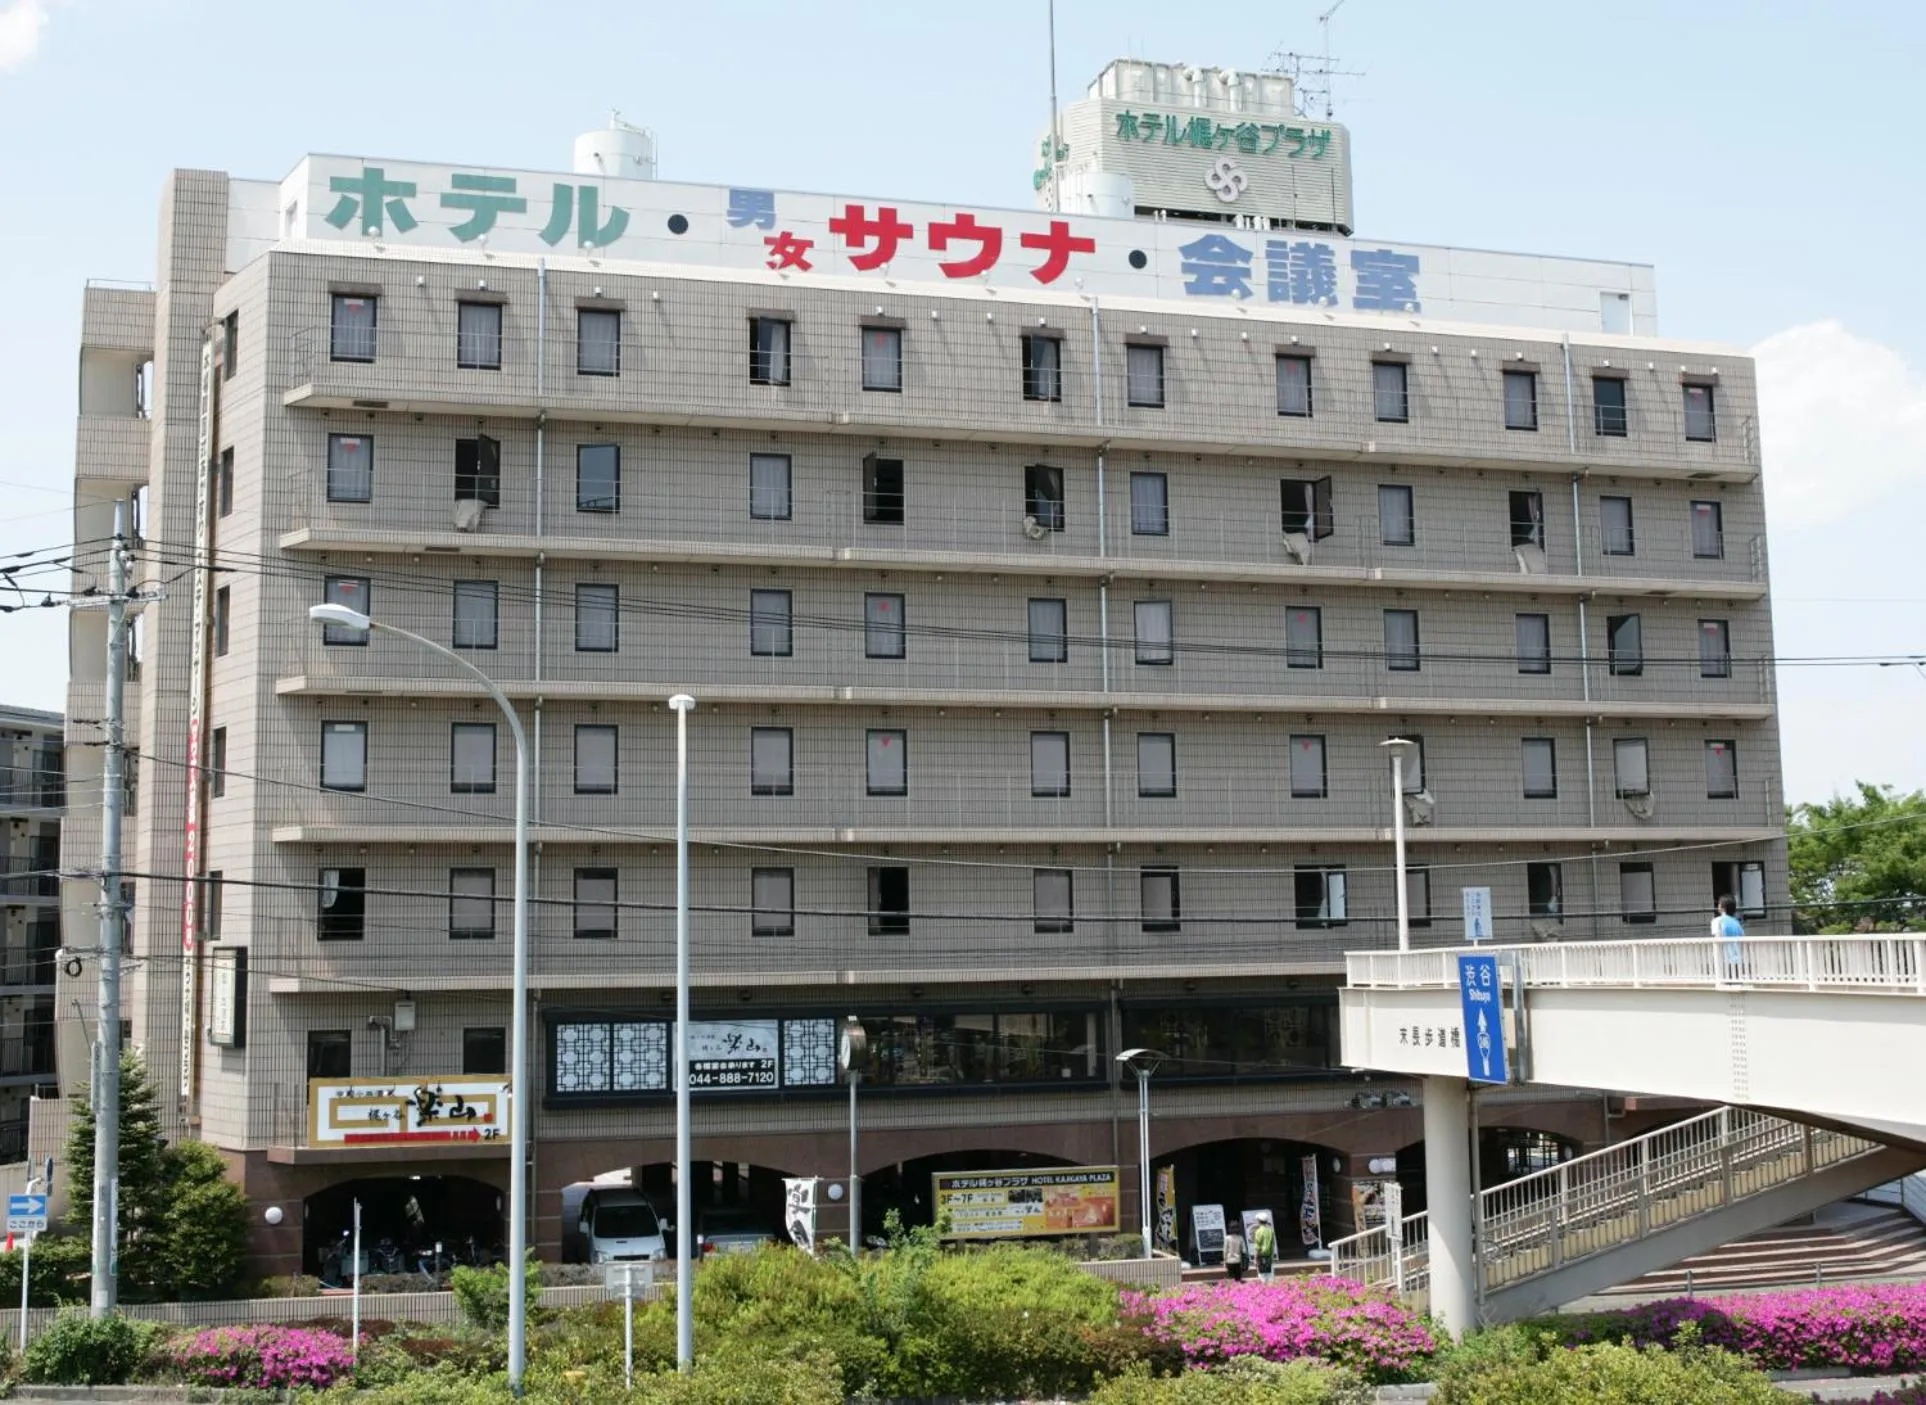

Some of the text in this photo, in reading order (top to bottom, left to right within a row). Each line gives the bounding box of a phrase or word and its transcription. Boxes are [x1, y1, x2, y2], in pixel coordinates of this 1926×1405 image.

[325, 167, 1421, 313] ホテル 男 女 サウナ 会議室
[1465, 964, 1491, 987] 渋谷
[1469, 989, 1491, 1003] Shibuya
[760, 1059, 774, 1069] 2F
[689, 1071, 774, 1085] 044-888-7120
[484, 1129, 500, 1141] 2F
[1089, 1172, 1113, 1182] PLAZA
